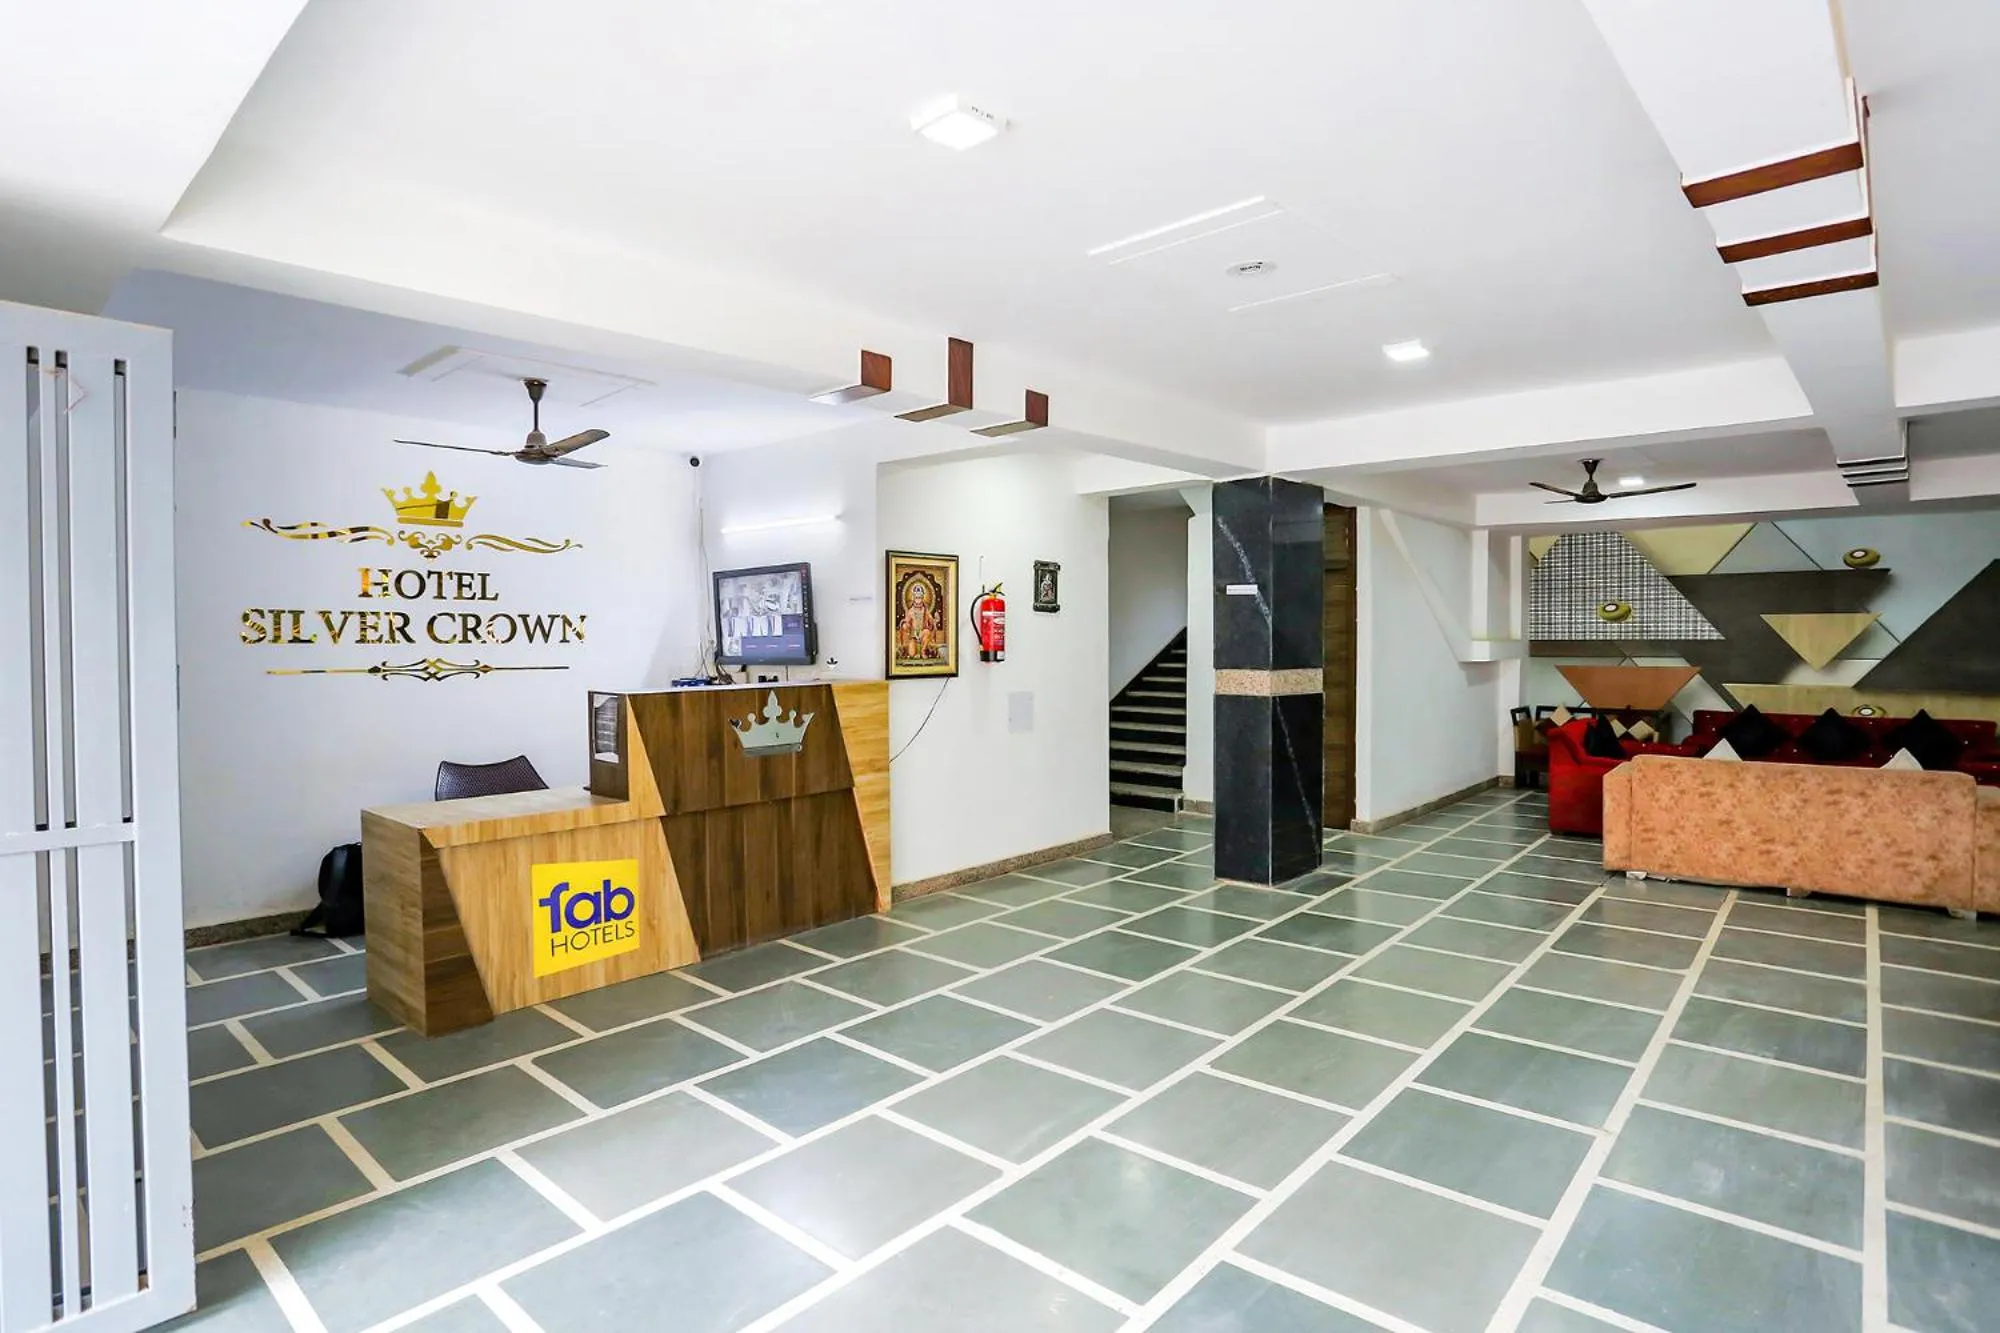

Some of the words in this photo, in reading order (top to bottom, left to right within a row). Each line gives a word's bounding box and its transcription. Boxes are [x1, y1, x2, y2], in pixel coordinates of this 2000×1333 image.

[358, 567, 499, 601] HOTEL
[240, 608, 416, 645] SILVER
[427, 611, 588, 645] CROWN
[539, 879, 635, 933] fab
[551, 921, 635, 957] HOTELS
